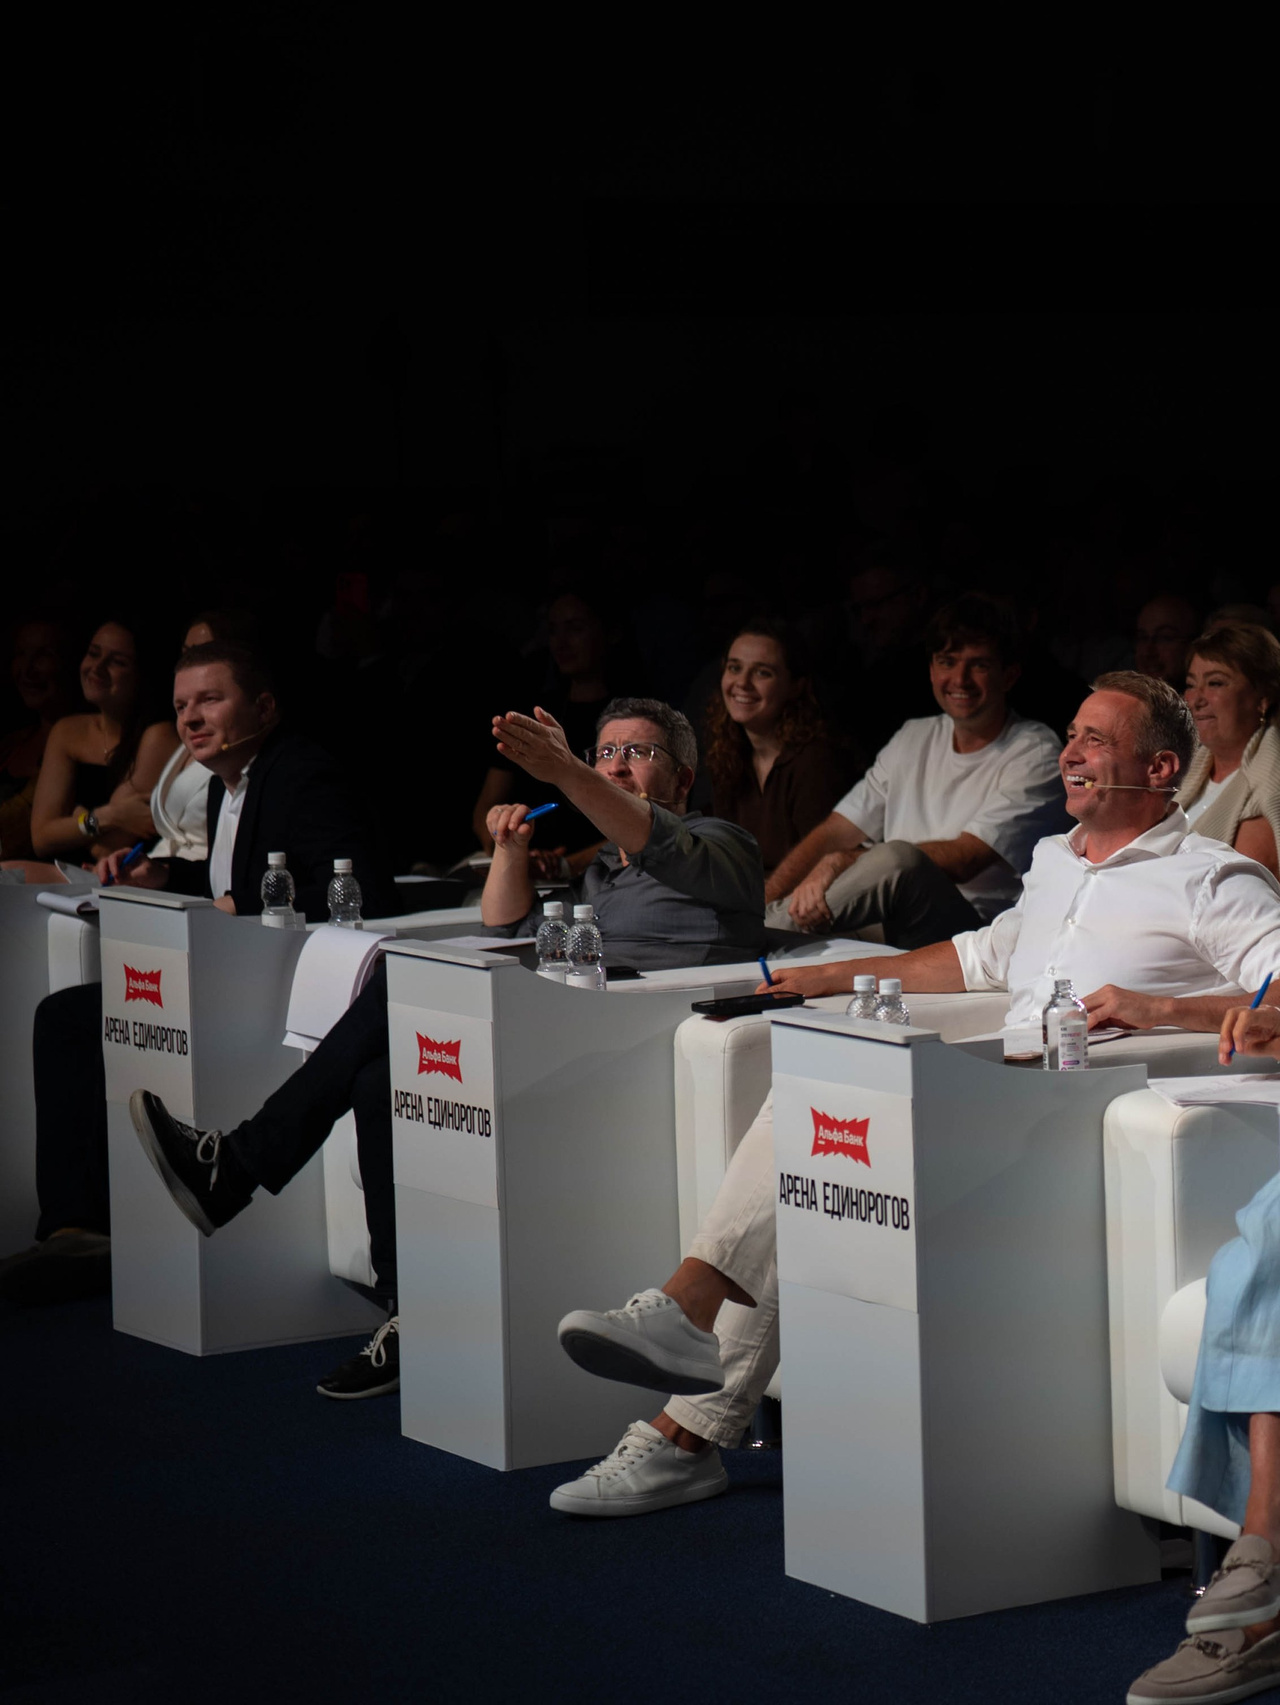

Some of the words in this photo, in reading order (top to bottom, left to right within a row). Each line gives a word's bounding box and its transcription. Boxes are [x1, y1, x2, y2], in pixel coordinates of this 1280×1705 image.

[104, 1016, 131, 1045] АРЕНА
[133, 1021, 188, 1056] ЕДИНОРОГОВ
[394, 1089, 424, 1123] АРЕНА
[427, 1096, 492, 1138] ЕДИНОРОГОВ
[817, 1124, 843, 1146] Альфа
[843, 1129, 864, 1147] Банк
[779, 1172, 818, 1212] АРЕНА
[823, 1181, 910, 1231] ЕДИНОРОГОВ
